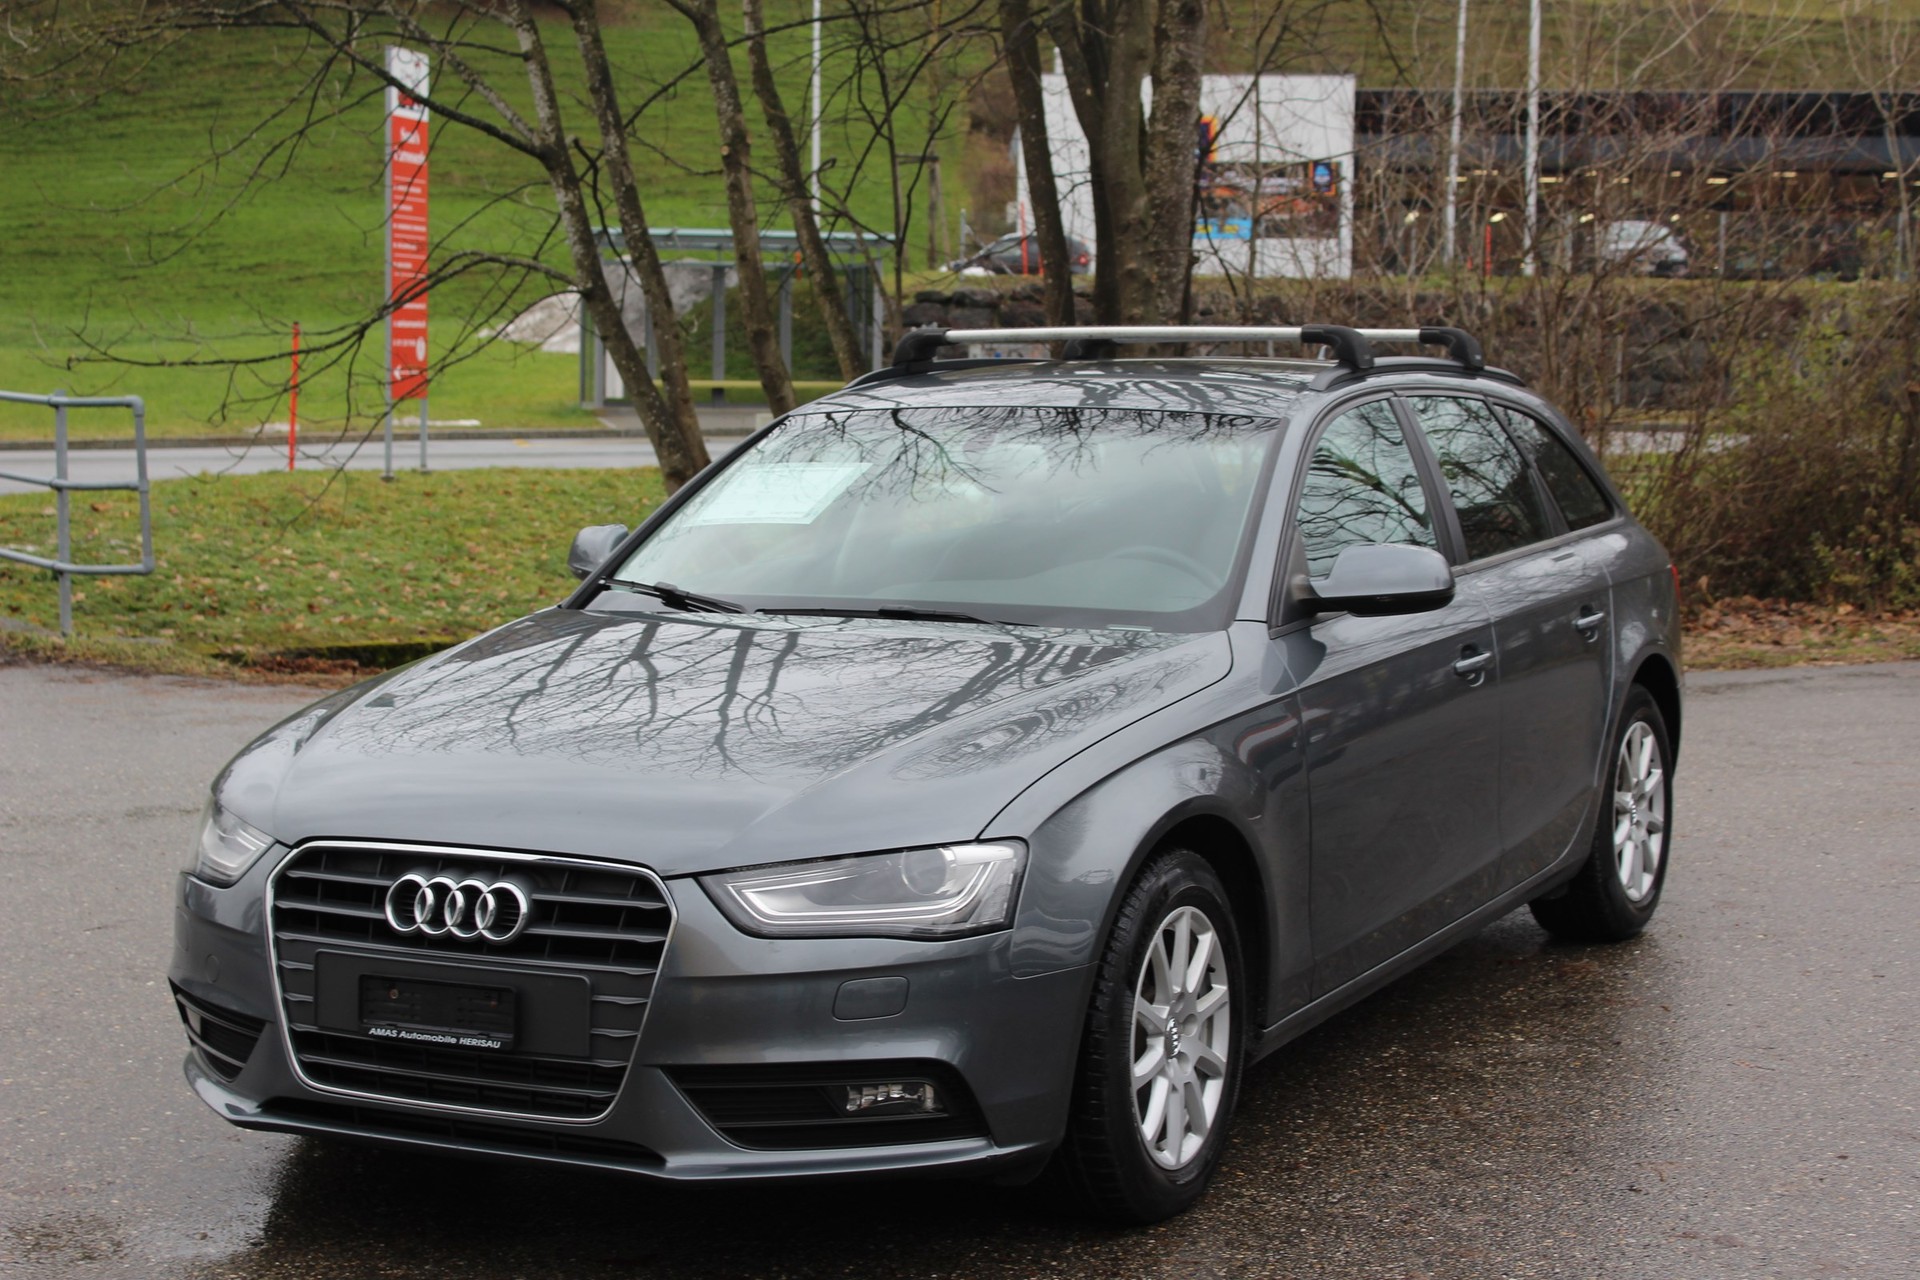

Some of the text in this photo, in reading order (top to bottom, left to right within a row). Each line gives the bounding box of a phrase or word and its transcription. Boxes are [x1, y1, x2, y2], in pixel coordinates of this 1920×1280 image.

[368, 1028, 501, 1048] AMAS Automobile HERISAU
